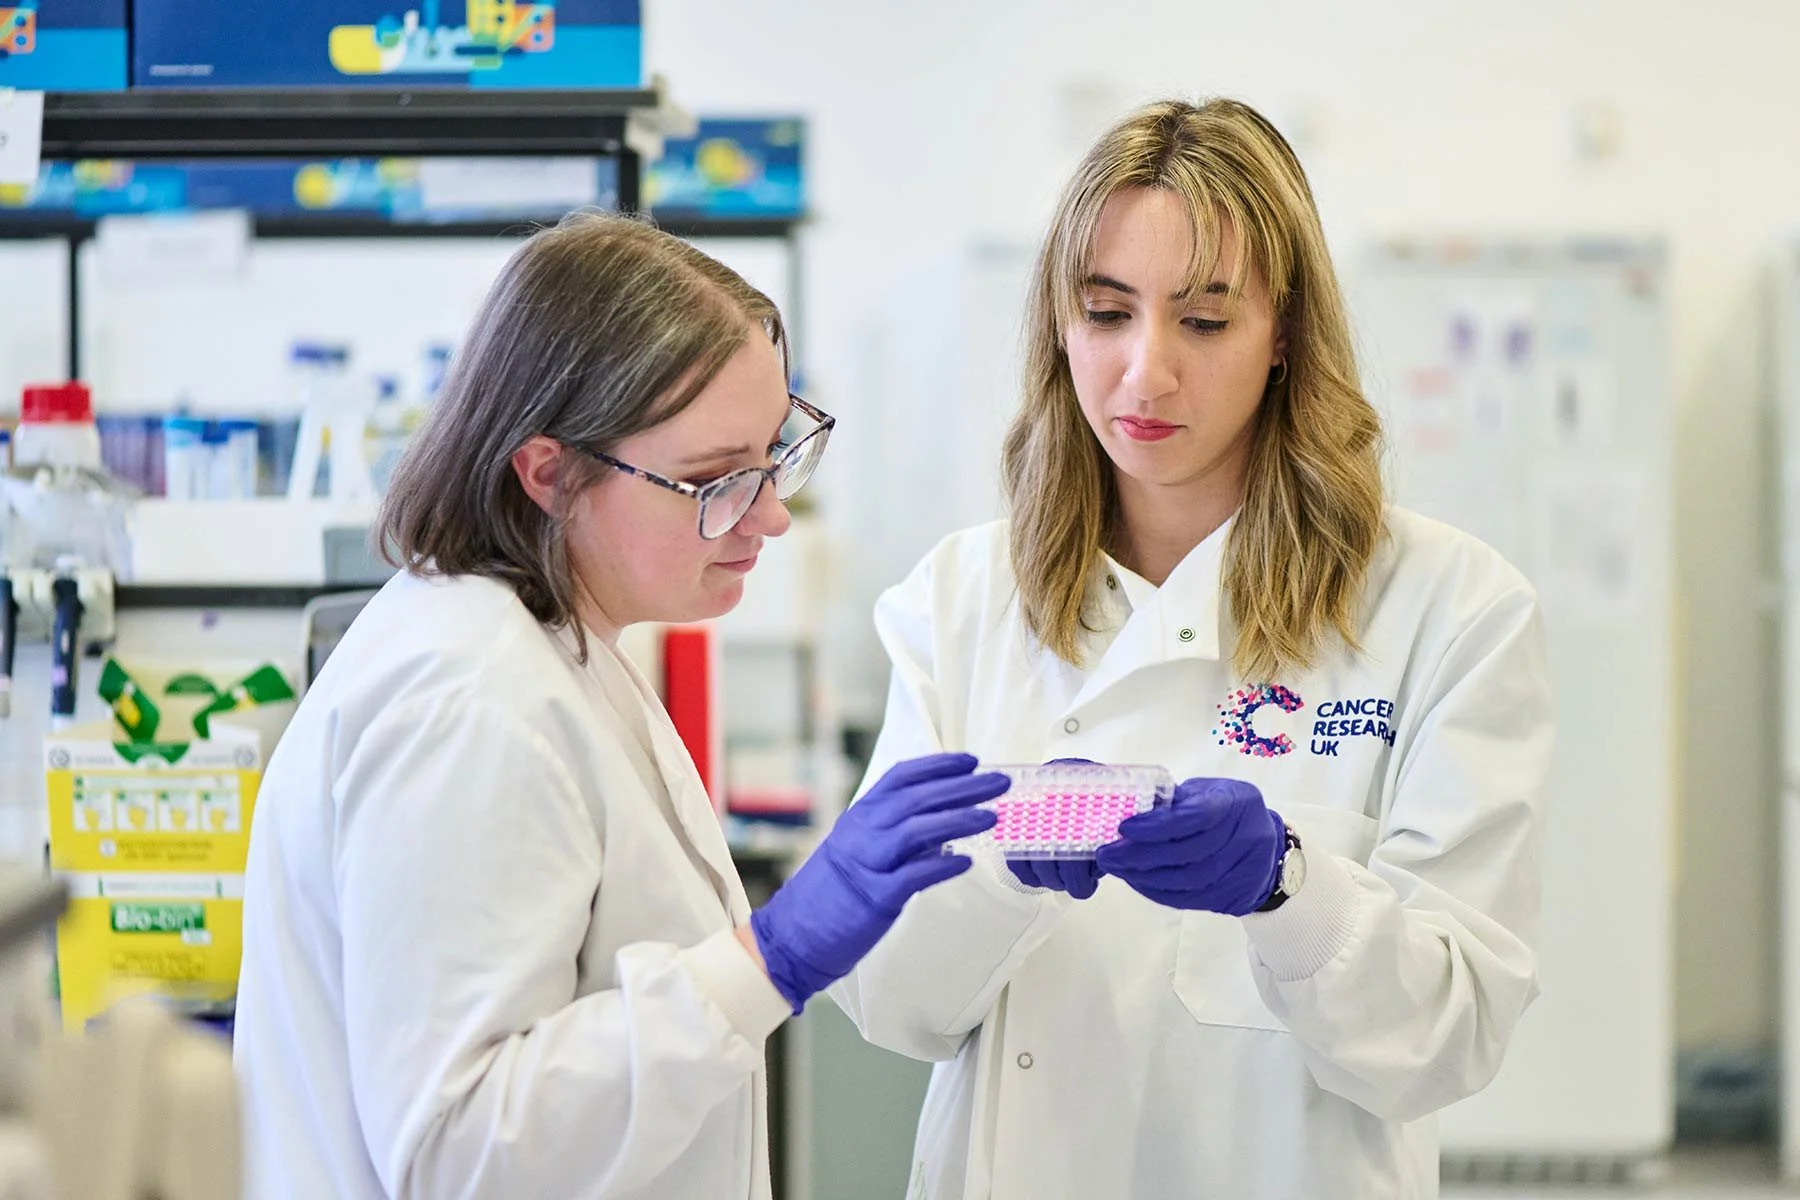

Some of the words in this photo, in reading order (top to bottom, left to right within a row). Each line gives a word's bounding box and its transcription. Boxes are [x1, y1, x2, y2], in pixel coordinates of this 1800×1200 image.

[1317, 698, 1394, 719] CANCER
[1313, 719, 1397, 747] RESEARH
[1310, 739, 1340, 757] UK
